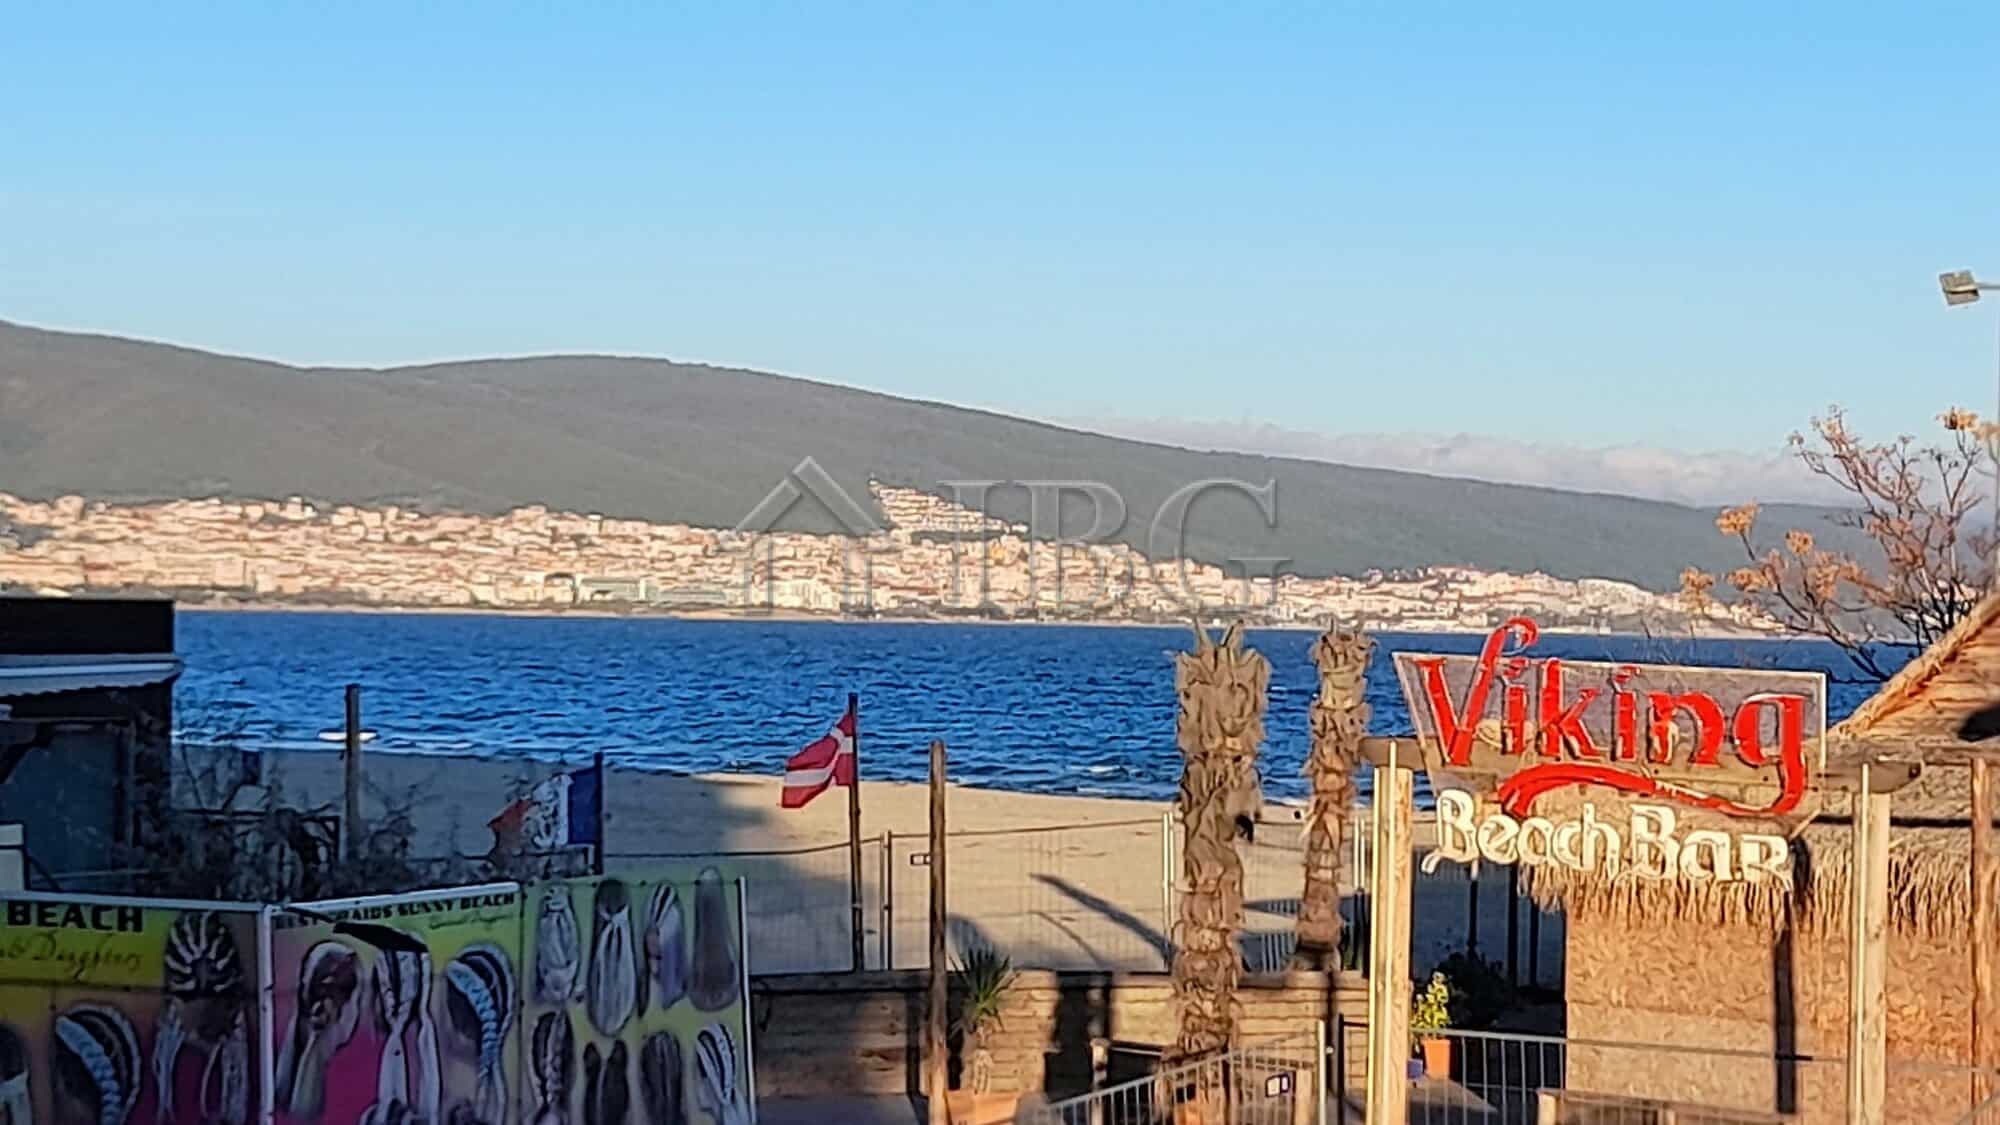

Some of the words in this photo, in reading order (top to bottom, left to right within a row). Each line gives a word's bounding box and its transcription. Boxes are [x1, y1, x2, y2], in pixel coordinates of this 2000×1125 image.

[1412, 616, 1810, 817] Viking
[1421, 788, 1622, 882] Beach
[8, 900, 143, 932] BEACH
[460, 893, 514, 910] BEACH
